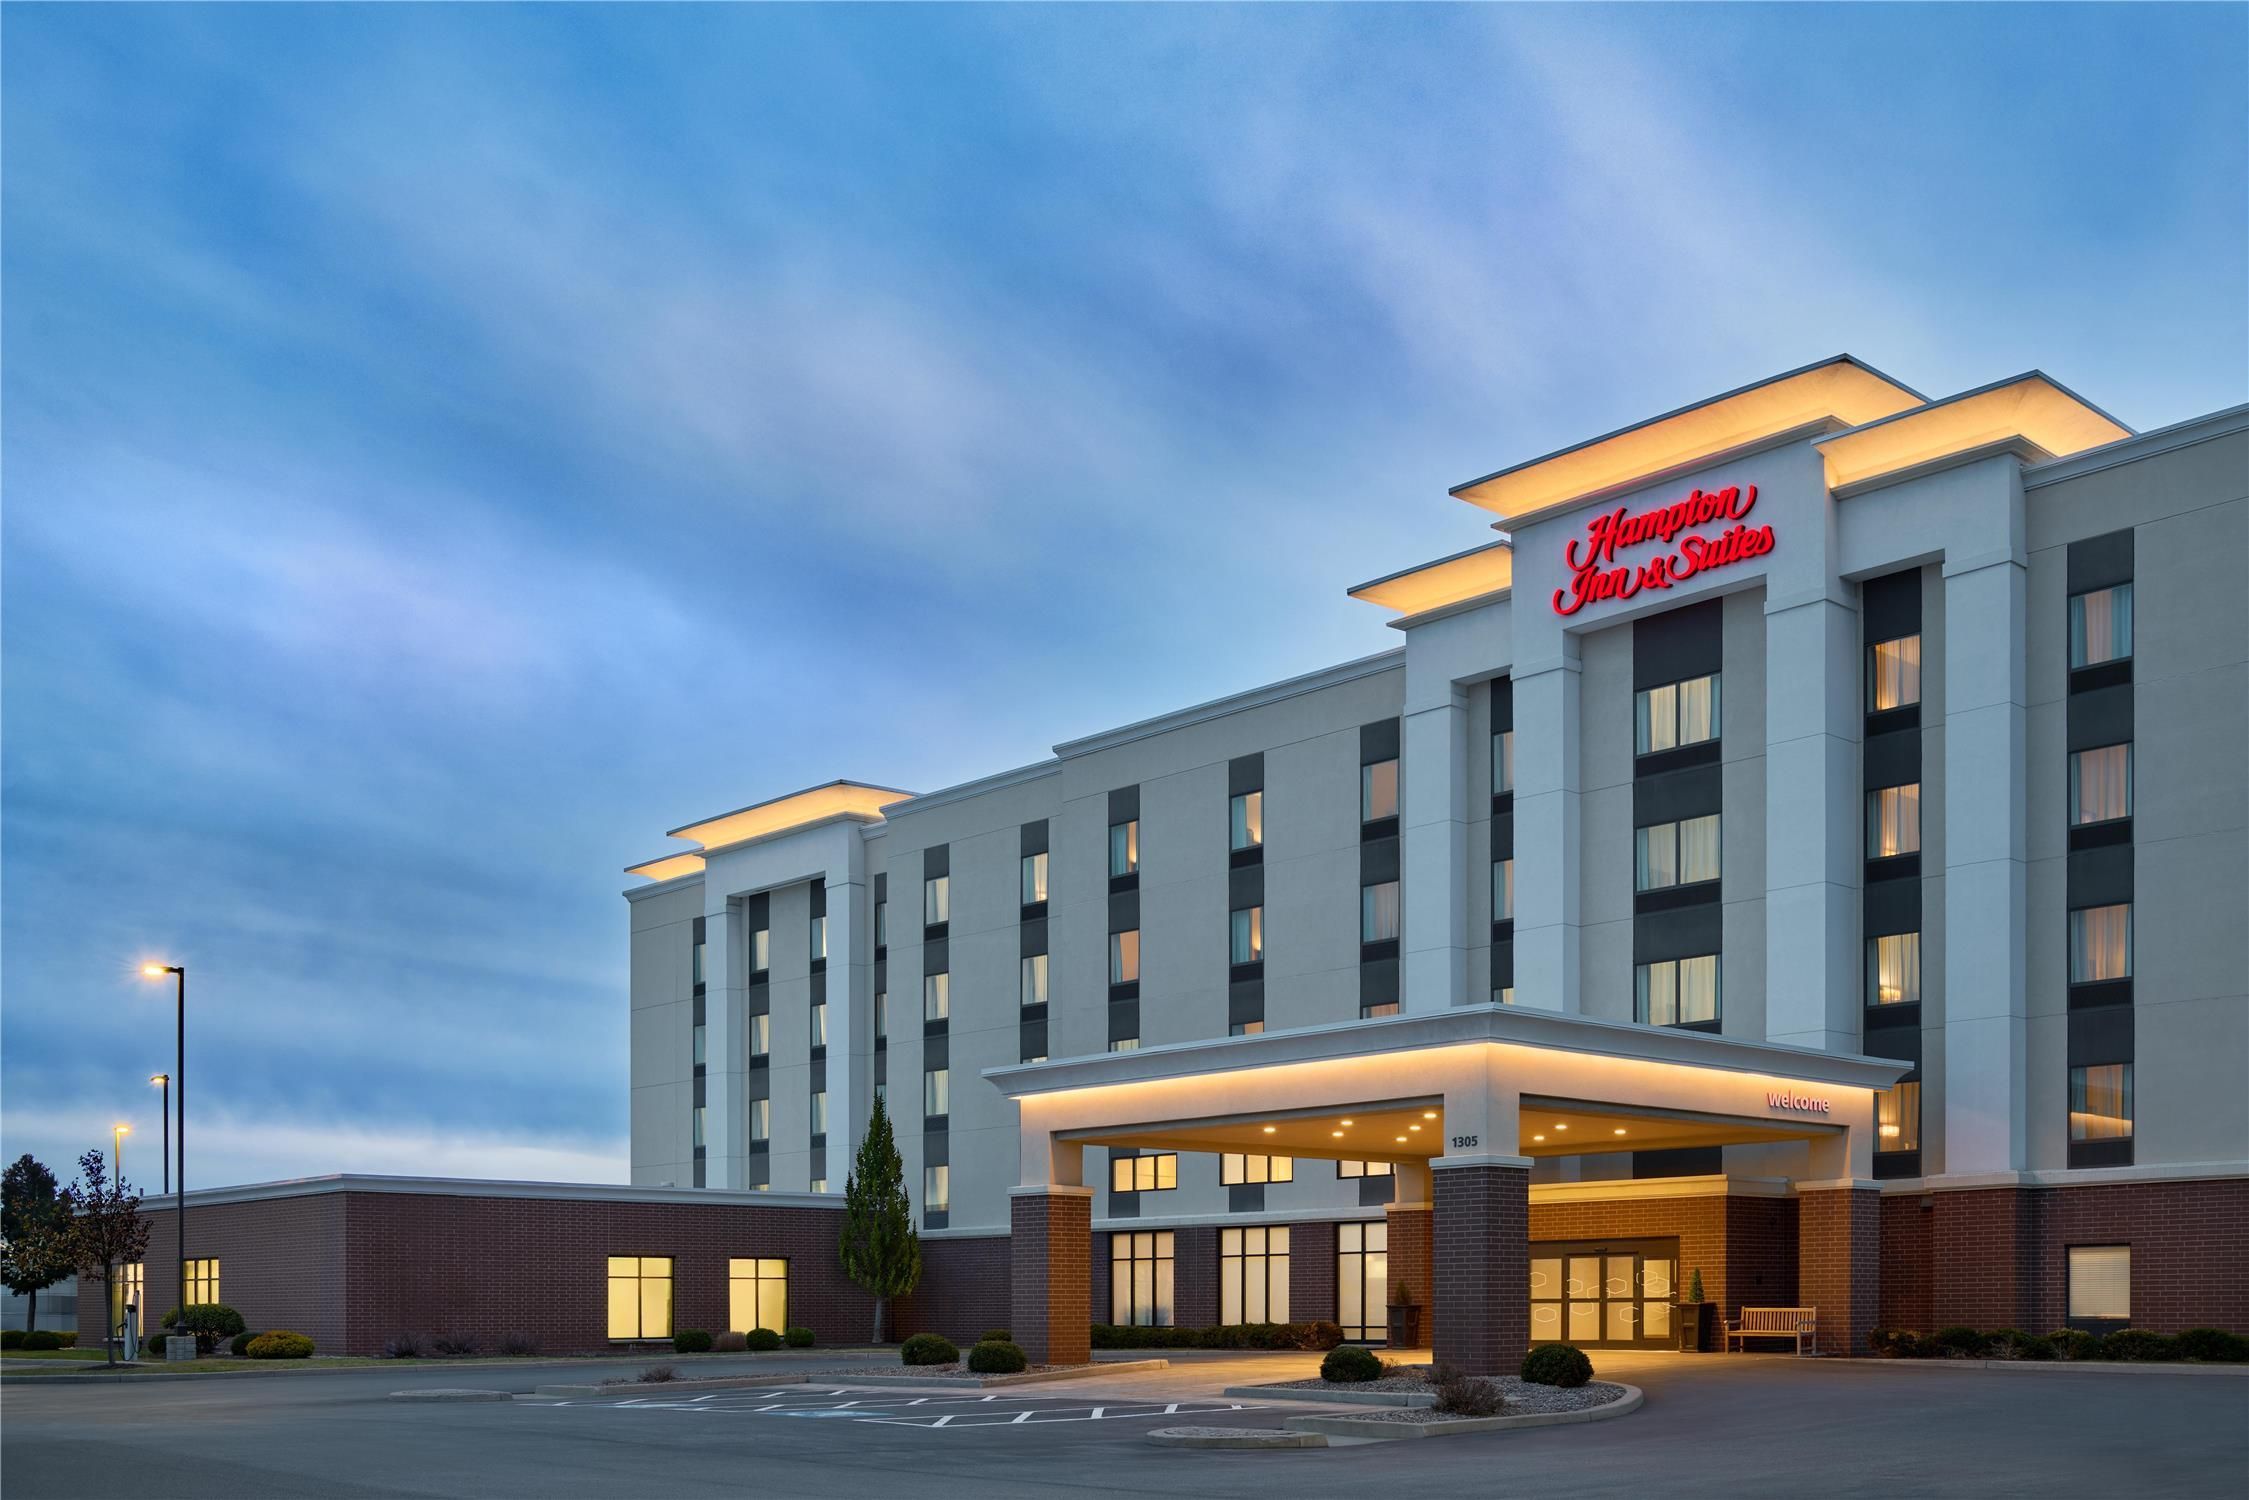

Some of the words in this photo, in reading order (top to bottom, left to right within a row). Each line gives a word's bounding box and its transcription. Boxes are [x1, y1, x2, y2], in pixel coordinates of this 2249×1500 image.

[1567, 484, 1758, 571] Hampton
[1553, 566, 1645, 615] Inn
[1641, 557, 1673, 588] &
[1666, 524, 1776, 580] Suites
[1767, 1089, 1830, 1113] welcome
[1452, 1135, 1479, 1148] 1305
